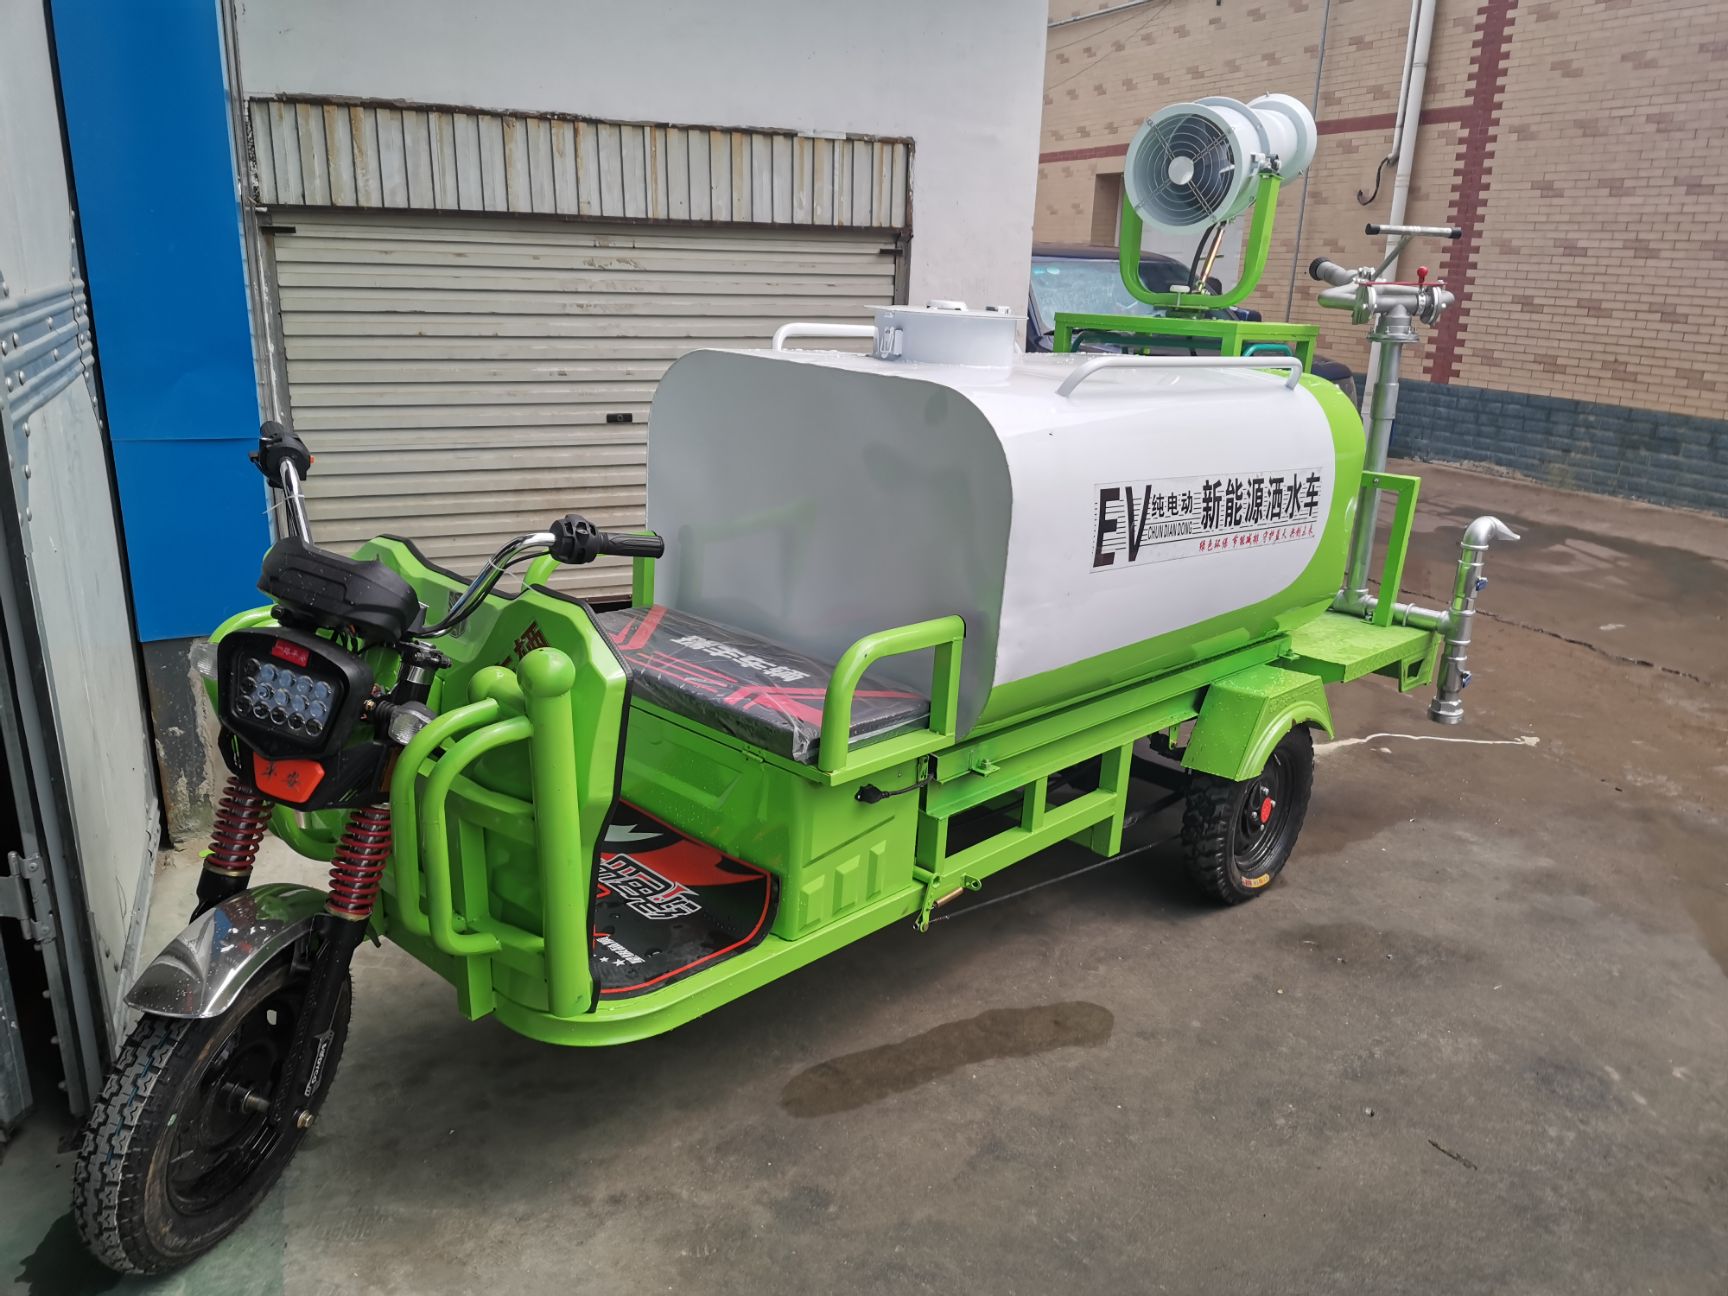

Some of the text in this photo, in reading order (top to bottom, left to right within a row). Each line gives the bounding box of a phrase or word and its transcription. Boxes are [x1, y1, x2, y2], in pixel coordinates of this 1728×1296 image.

[1093, 471, 1321, 568] EV 纯电动 新能源洒水车
